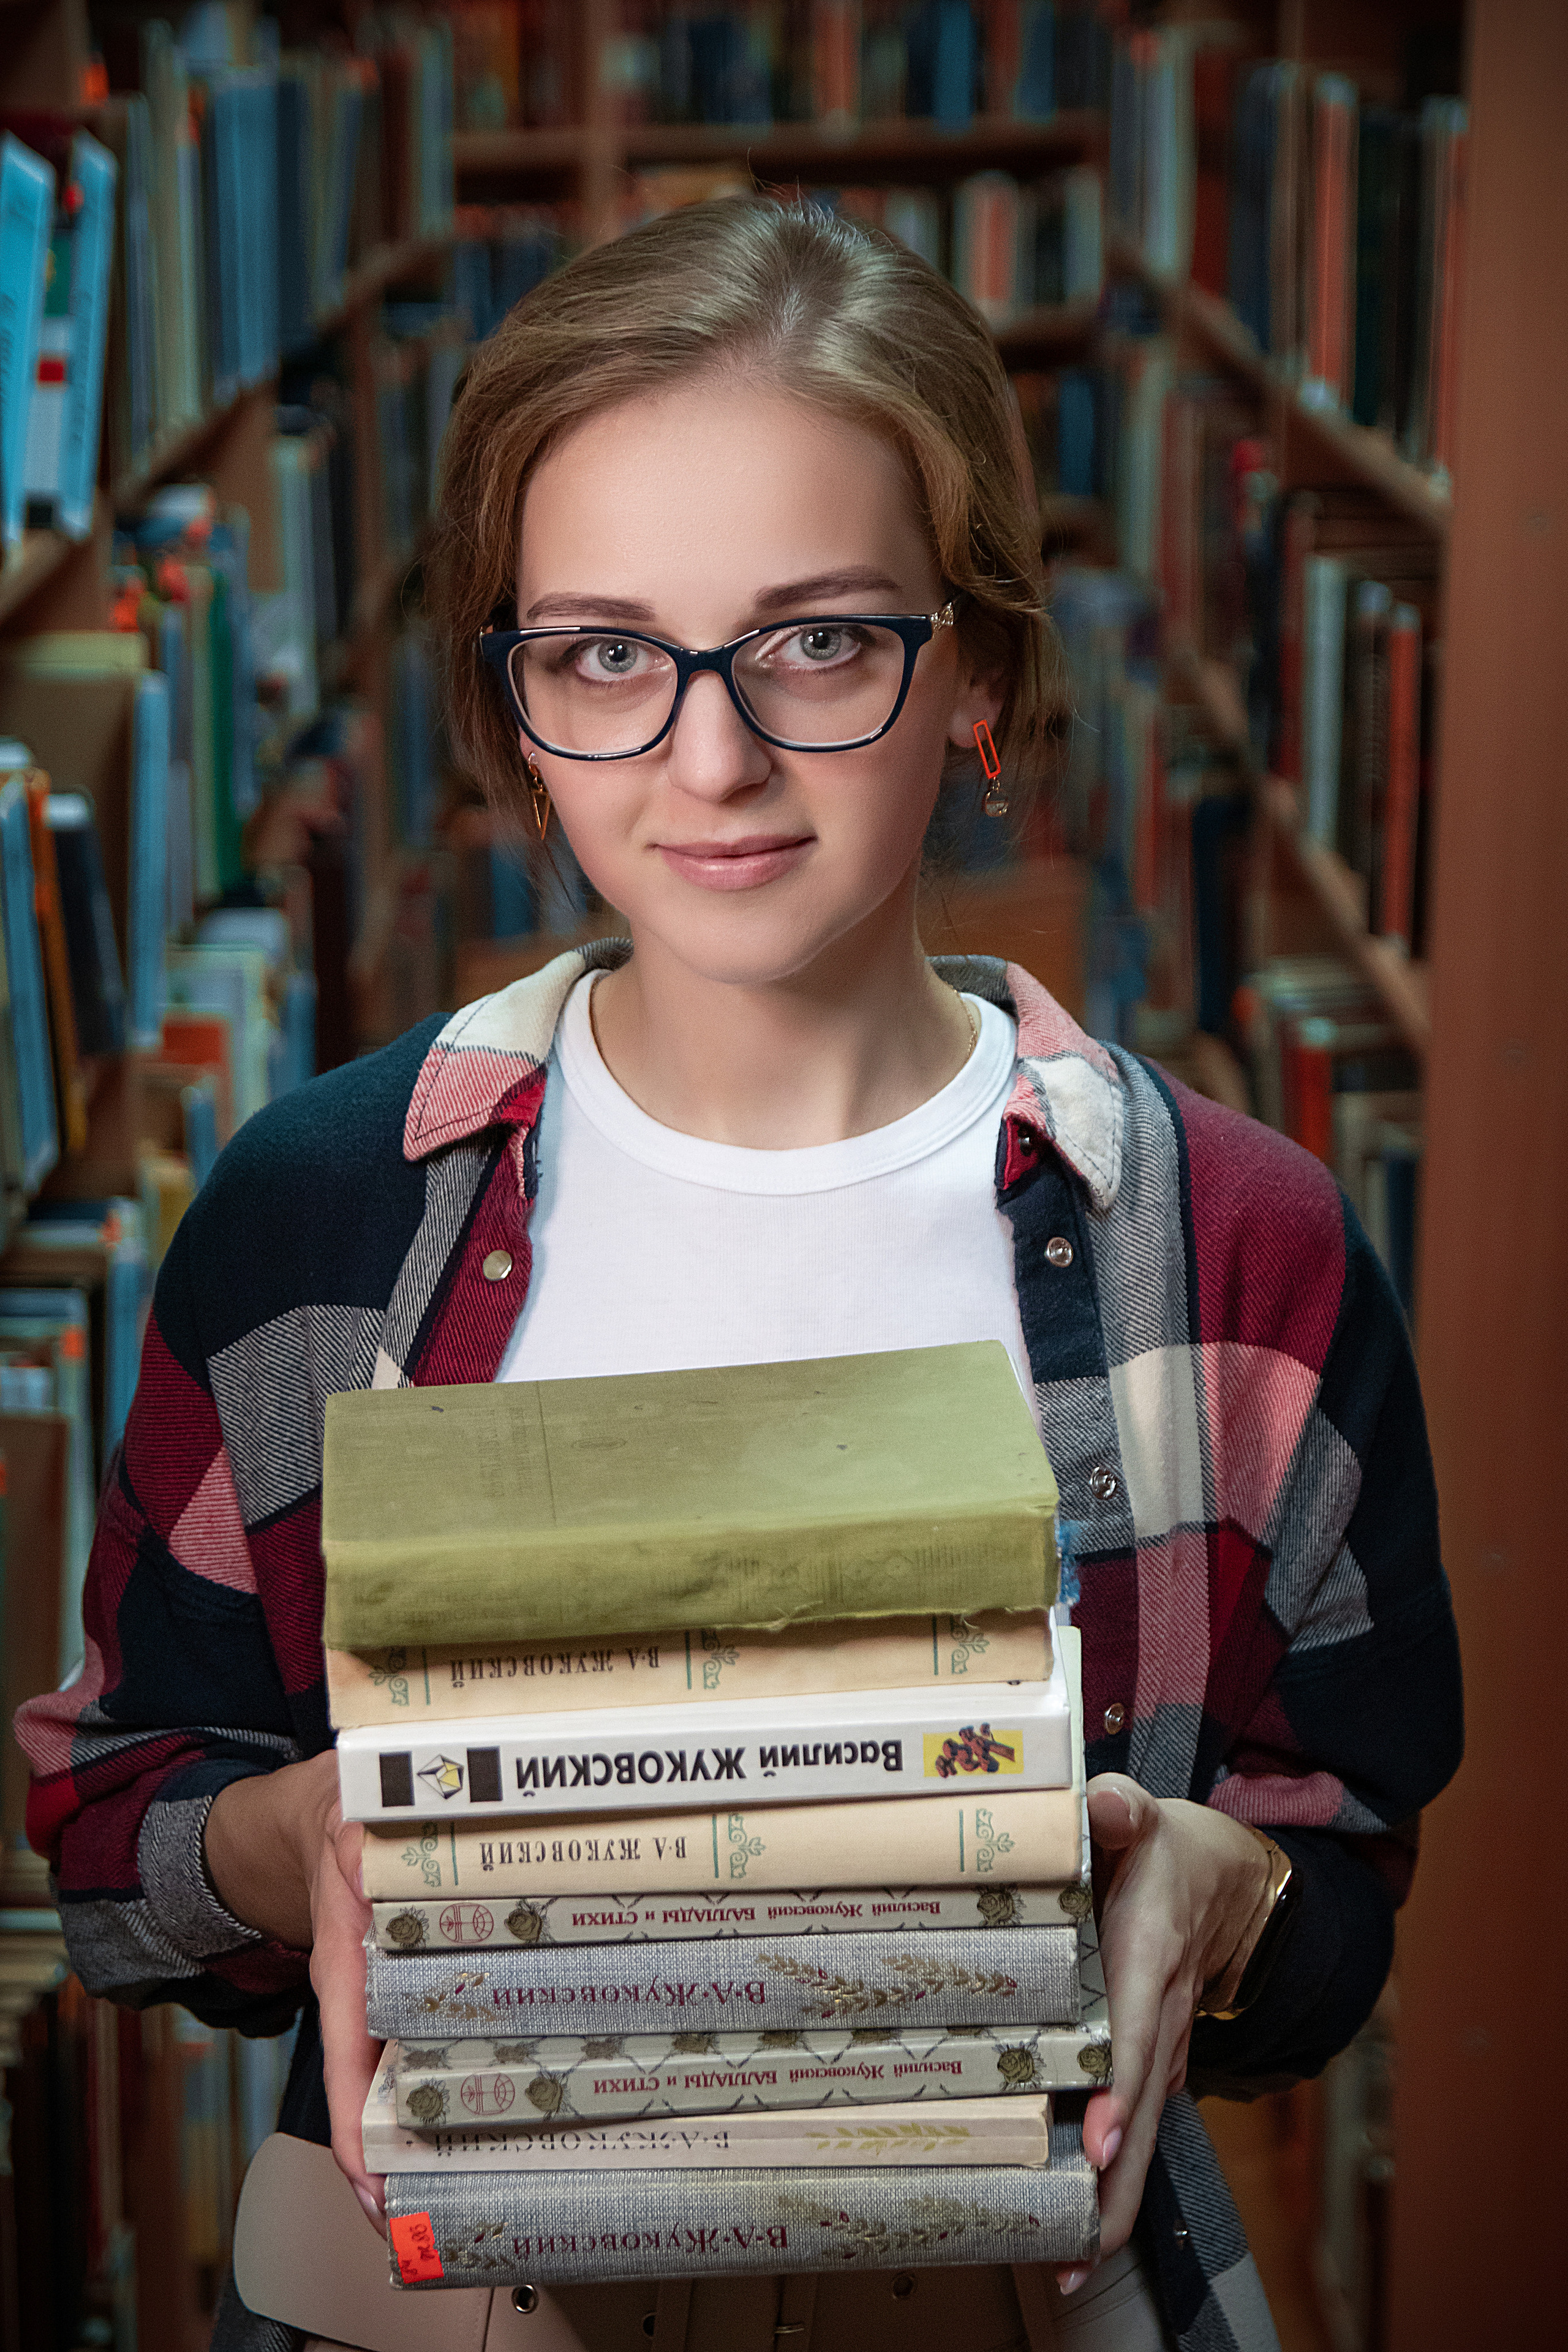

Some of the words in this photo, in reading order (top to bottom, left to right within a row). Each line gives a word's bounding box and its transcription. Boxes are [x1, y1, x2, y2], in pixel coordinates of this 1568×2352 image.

[450, 1648, 613, 1689] ЖУКОВСКИЙ
[759, 1739, 903, 1778] Василий
[515, 1746, 747, 1798] ЖУКОВСКИЙ
[479, 1838, 641, 1872] ЖУКОВСКИЙ
[645, 1910, 655, 1921] и
[662, 1906, 756, 1924] БАЛЛАДЫ
[767, 1902, 864, 1920] Жуковский
[871, 1901, 941, 1916] Василий
[571, 1910, 638, 1927] СТИХИ
[789, 2064, 884, 2082] Жуковский
[893, 2060, 963, 2076] Василий
[593, 2076, 660, 2094] СТИХИ
[666, 2075, 677, 2086] и
[684, 2070, 778, 2089] БАЛЛАДЫ
